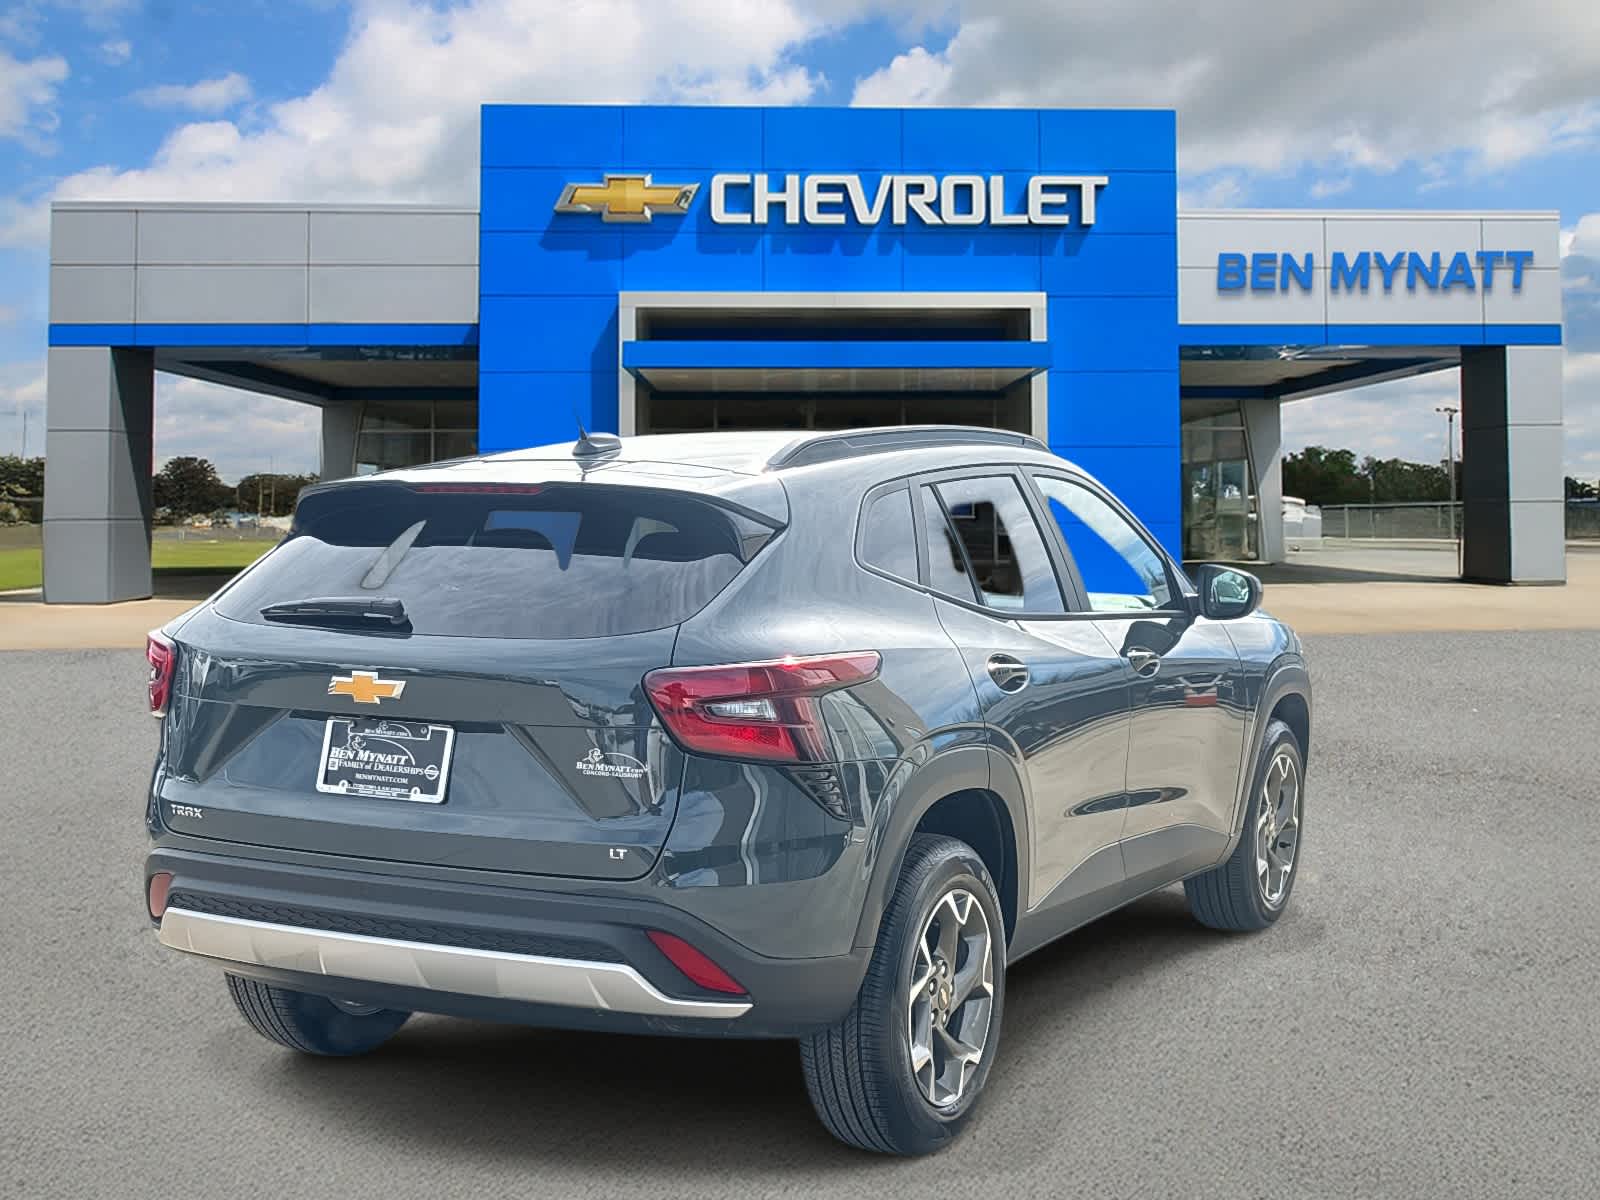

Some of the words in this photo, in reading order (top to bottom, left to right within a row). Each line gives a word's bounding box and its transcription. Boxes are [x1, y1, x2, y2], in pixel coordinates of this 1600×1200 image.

[710, 173, 1109, 225] CHEVROLET
[1217, 252, 1313, 290] BEN
[1330, 250, 1534, 290] MYNATT
[330, 746, 356, 761] BEN
[356, 749, 409, 765] MYNATT
[339, 759, 366, 770] FAMILY
[373, 762, 425, 776] DEALERSHIPS
[170, 803, 203, 819] TRAX
[609, 848, 628, 860] LT
